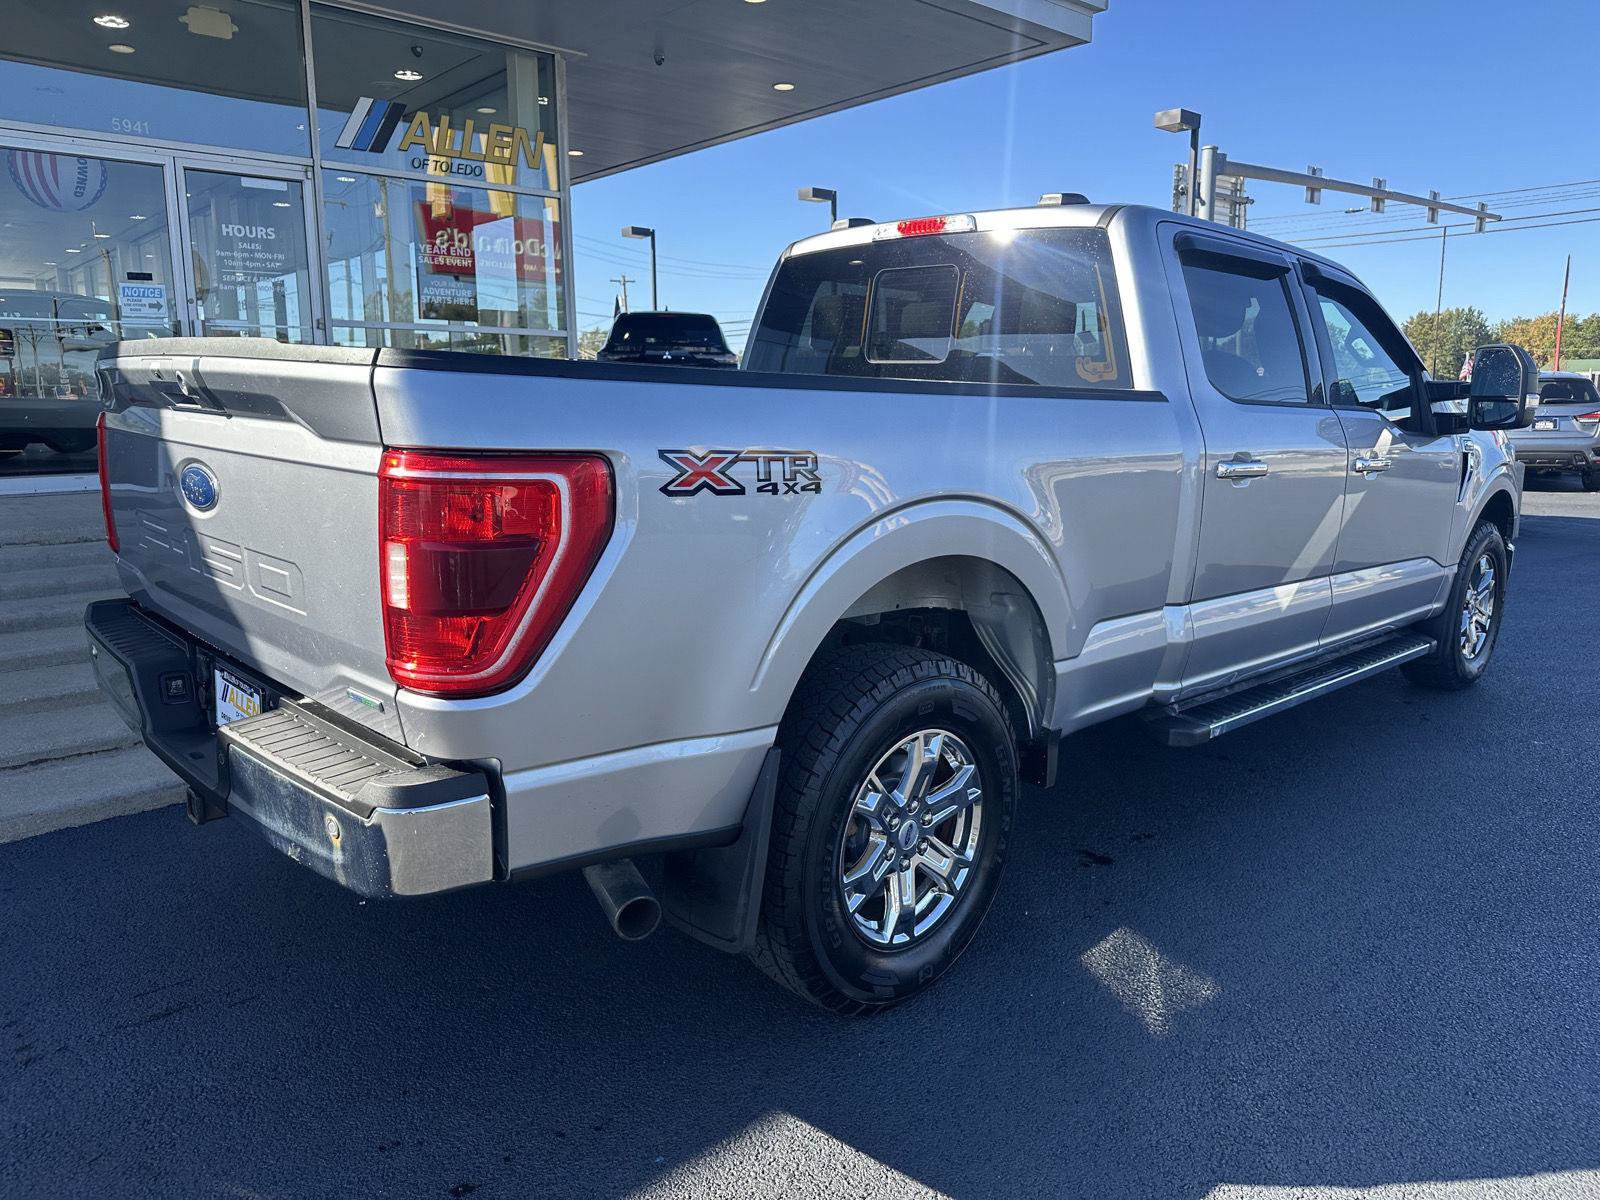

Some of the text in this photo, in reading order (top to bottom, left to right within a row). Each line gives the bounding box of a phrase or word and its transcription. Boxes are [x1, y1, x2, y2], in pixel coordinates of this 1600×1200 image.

[111, 118, 150, 135] 5941
[399, 111, 545, 170] ALLEN
[411, 157, 483, 177] OF TOLEDO
[73, 157, 88, 198] OWNED
[221, 223, 276, 239] HOURS
[418, 243, 471, 257] YEAR END
[418, 256, 473, 268] SALES EVENT
[124, 287, 161, 297] NOTICE
[423, 287, 473, 298] ADVENTURE
[420, 295, 475, 306] STARTS HERE
[229, 687, 261, 717] ALLEN
